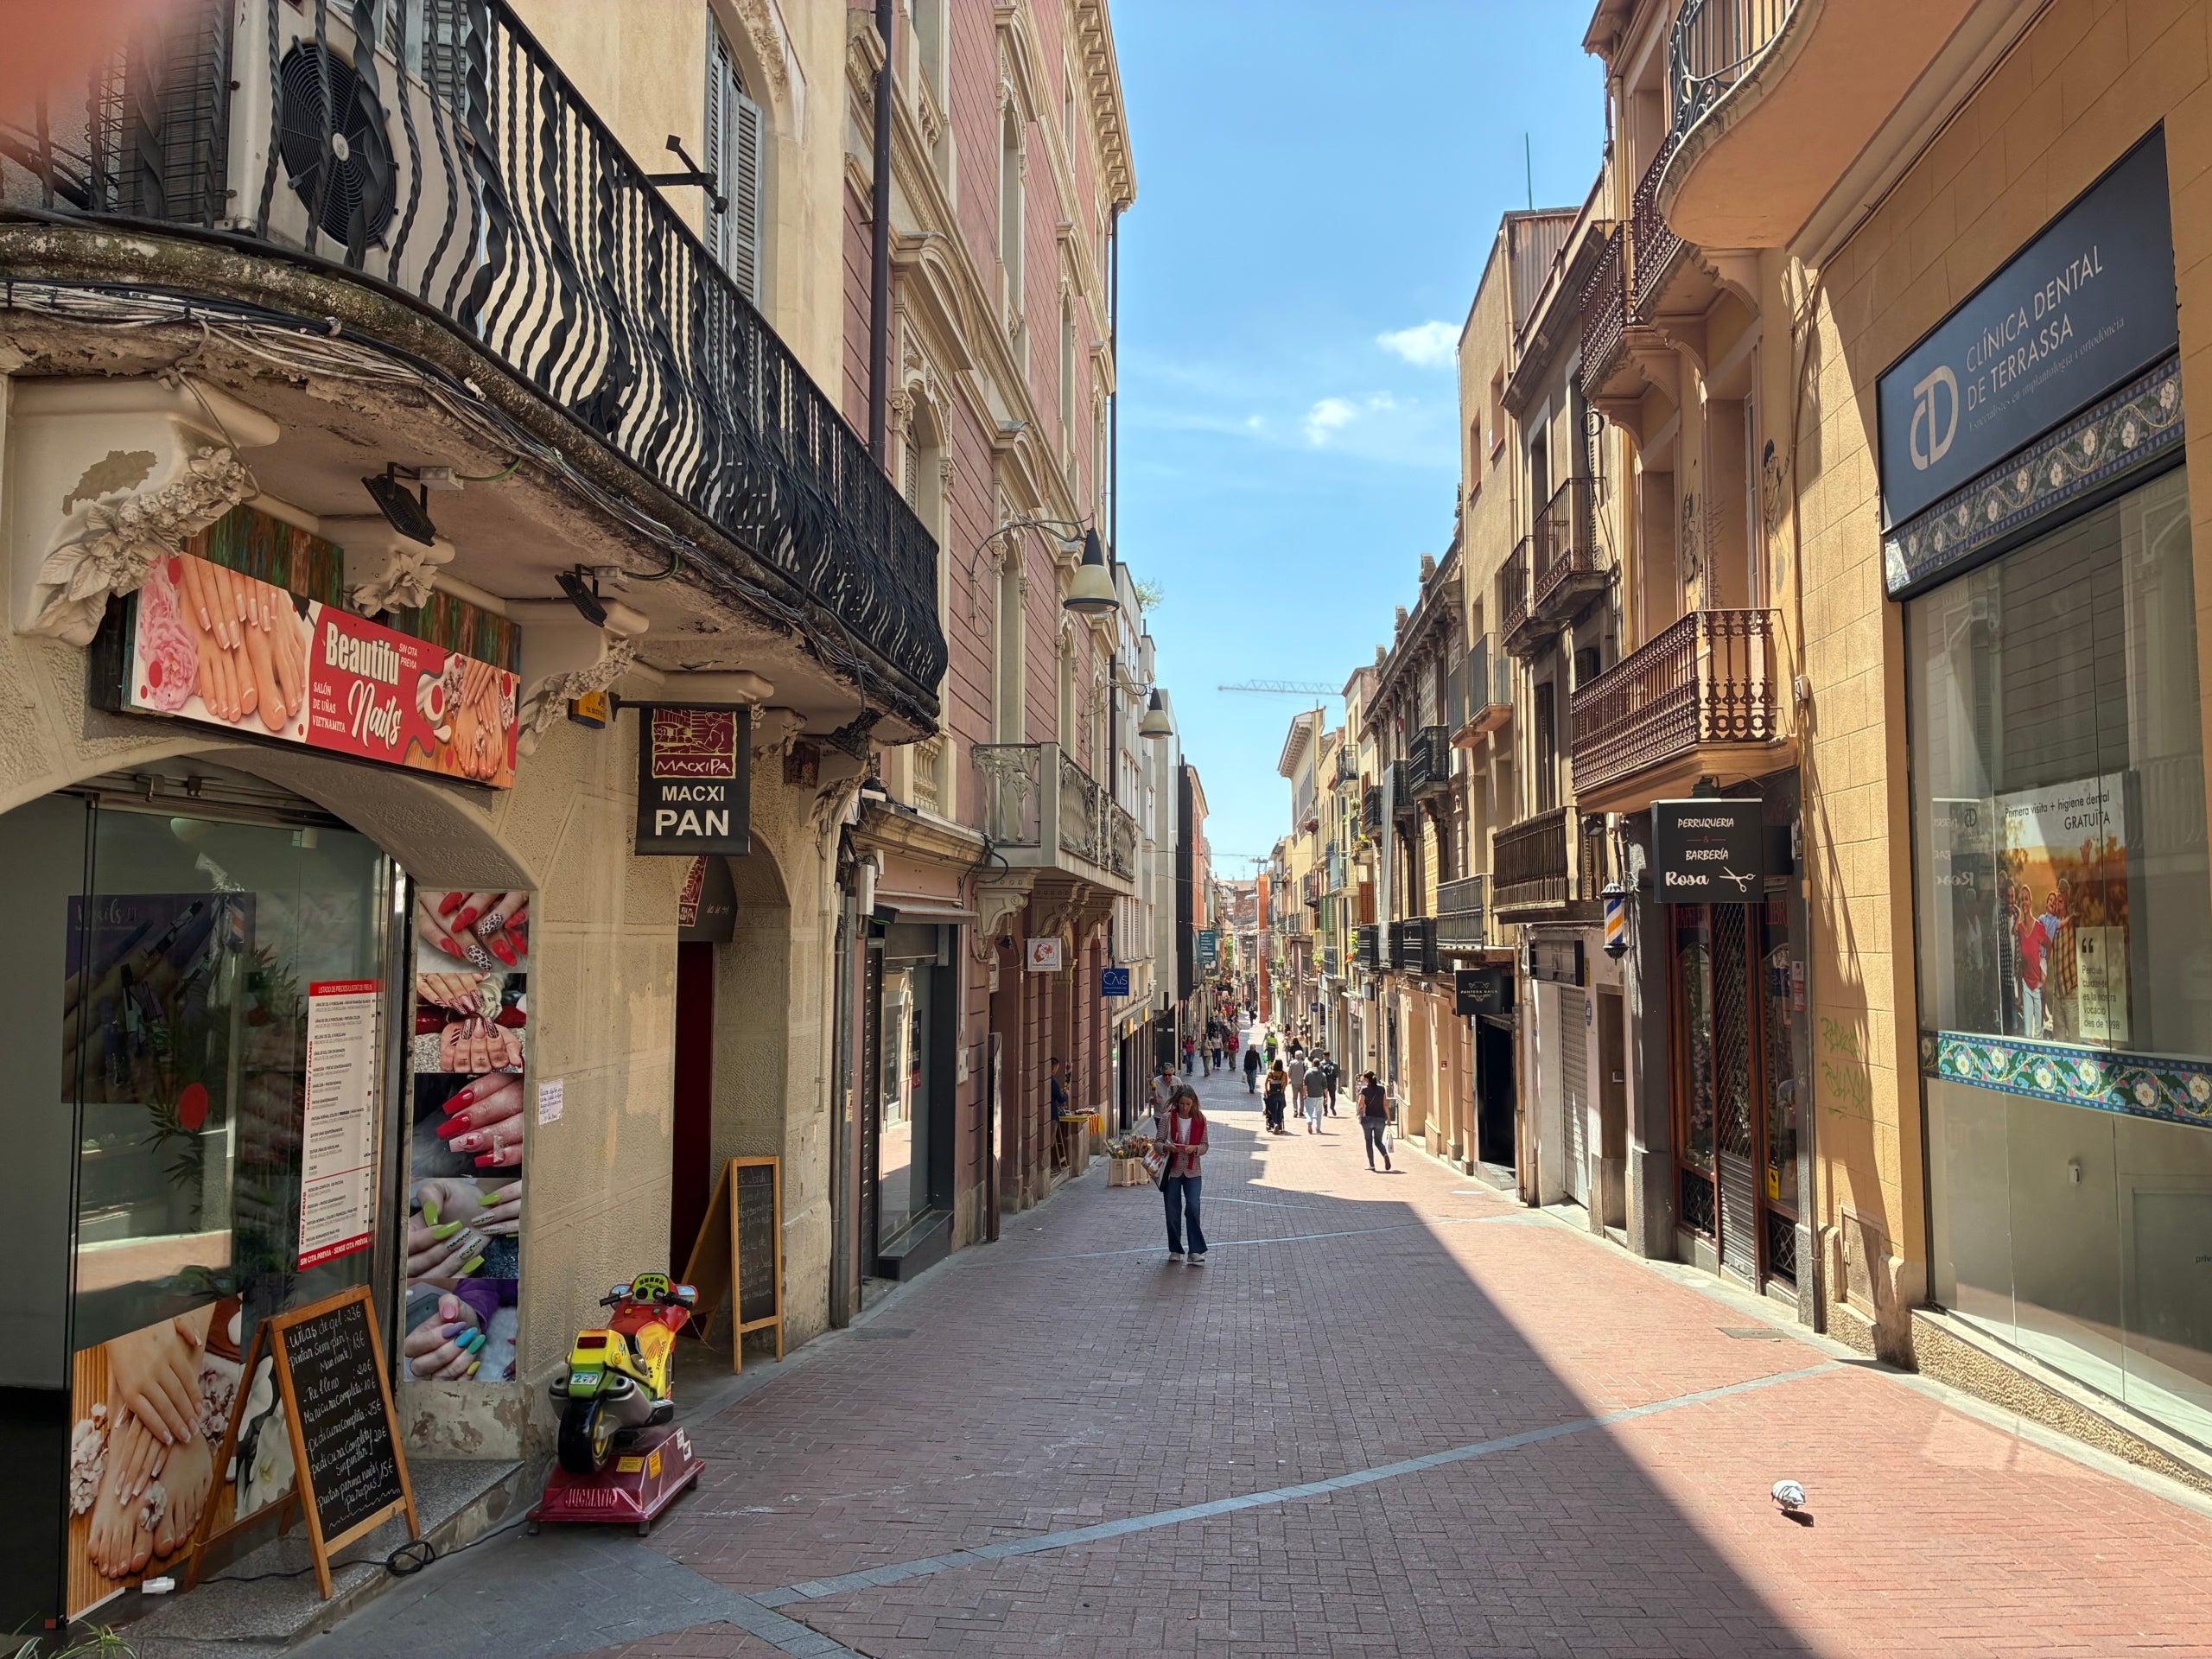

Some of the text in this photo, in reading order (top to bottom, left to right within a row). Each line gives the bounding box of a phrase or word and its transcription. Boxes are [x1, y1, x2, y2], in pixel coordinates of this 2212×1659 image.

[1967, 245, 2103, 372] CLÍNICA DENTAL
[1967, 313, 2074, 411] DE TERRASSA
[326, 621, 399, 686] Beautifu
[408, 646, 417, 657] CITA
[400, 657, 416, 670] PREVIA
[314, 681, 332, 696] SALÓN
[313, 698, 336, 714] DE UÑAS
[347, 680, 402, 751] Nails
[312, 715, 346, 733] VIETNAMITA
[662, 785, 724, 802] MACXI
[2005, 807, 2029, 818] Primera
[2031, 803, 2048, 815] visita
[2057, 797, 2084, 812] higiene
[655, 809, 728, 836] PAN
[1677, 817, 1734, 828] PERRUQUERIA
[2064, 809, 2110, 830] GRATUÏTA
[1686, 848, 1728, 861] BARBERÍA
[1665, 871, 1709, 886] Rosa
[2084, 1020, 2094, 1028] des
[2095, 1020, 2104, 1028] de
[317, 1250, 332, 1260] PREVIA
